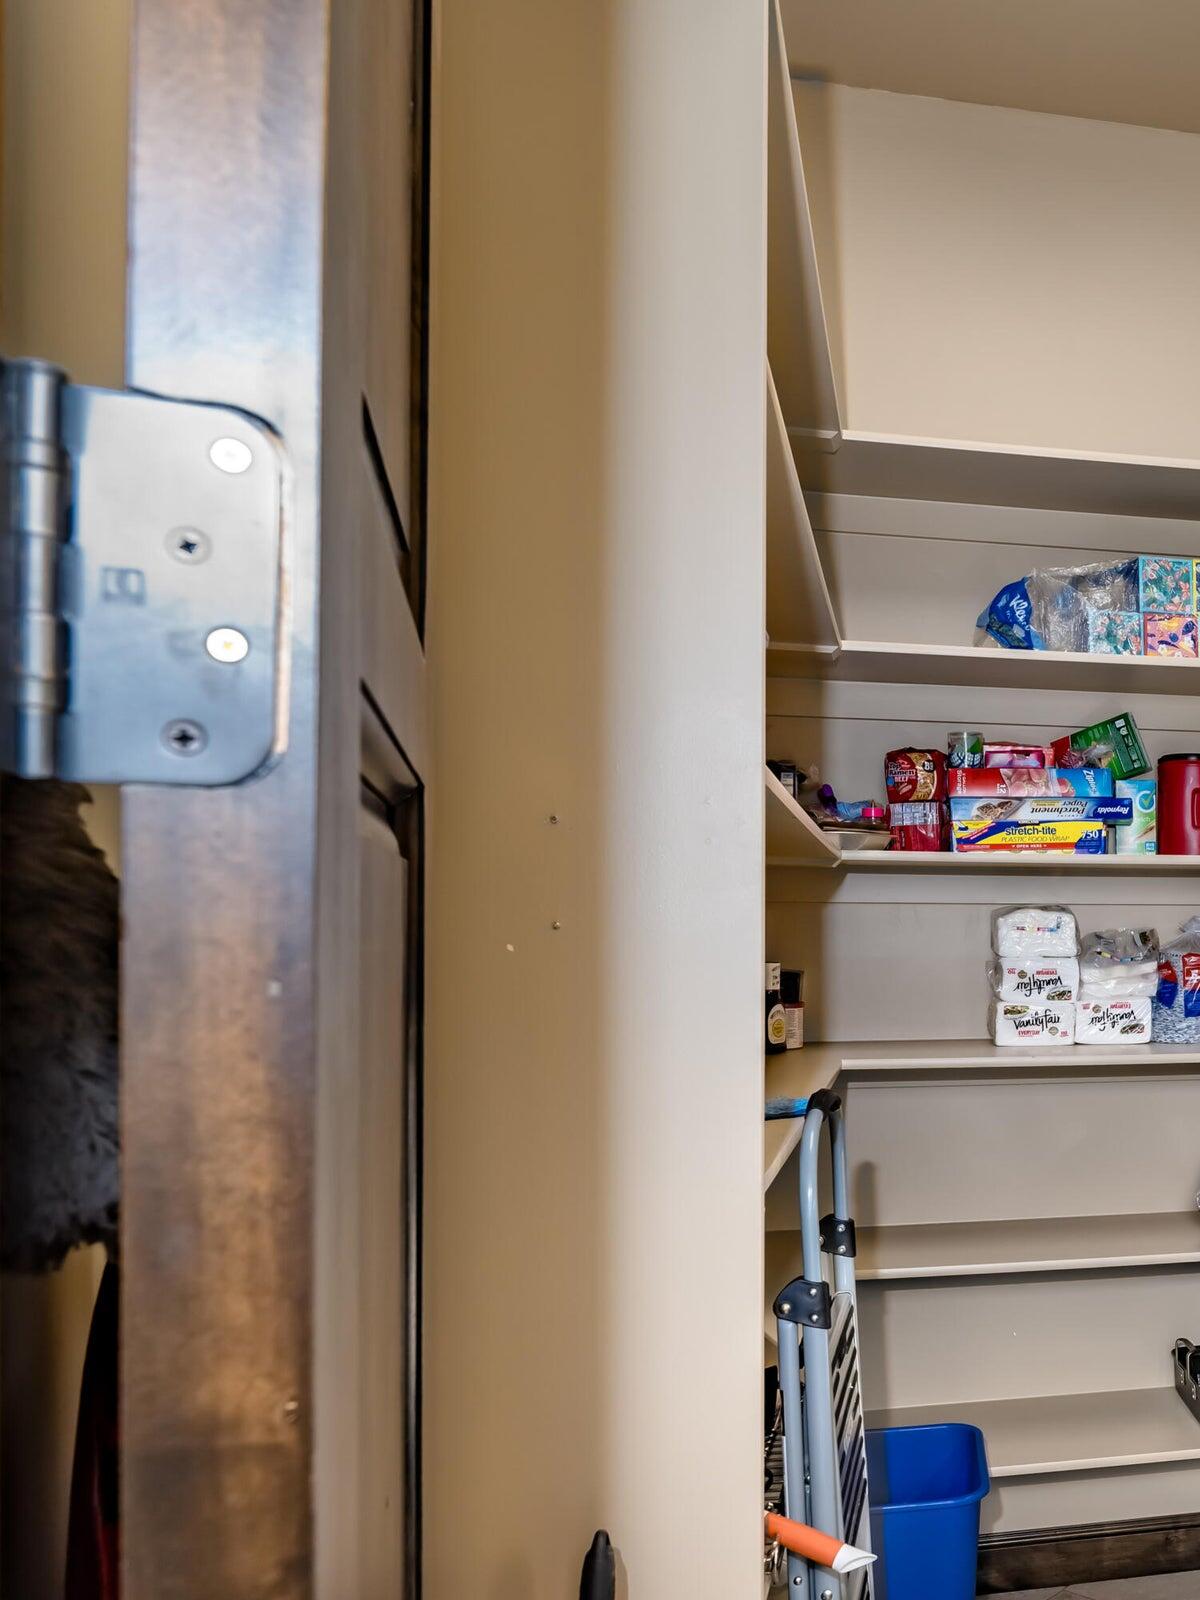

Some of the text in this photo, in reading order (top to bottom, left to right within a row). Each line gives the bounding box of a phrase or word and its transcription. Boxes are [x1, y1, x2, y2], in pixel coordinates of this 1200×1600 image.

[1000, 783, 1007, 794] 12
[1062, 799, 1088, 807] Paper
[1031, 806, 1086, 814] Parchment
[1097, 805, 1130, 814] Reynolds
[1004, 825, 1057, 836] stretch-tite
[1081, 830, 1099, 839] 750
